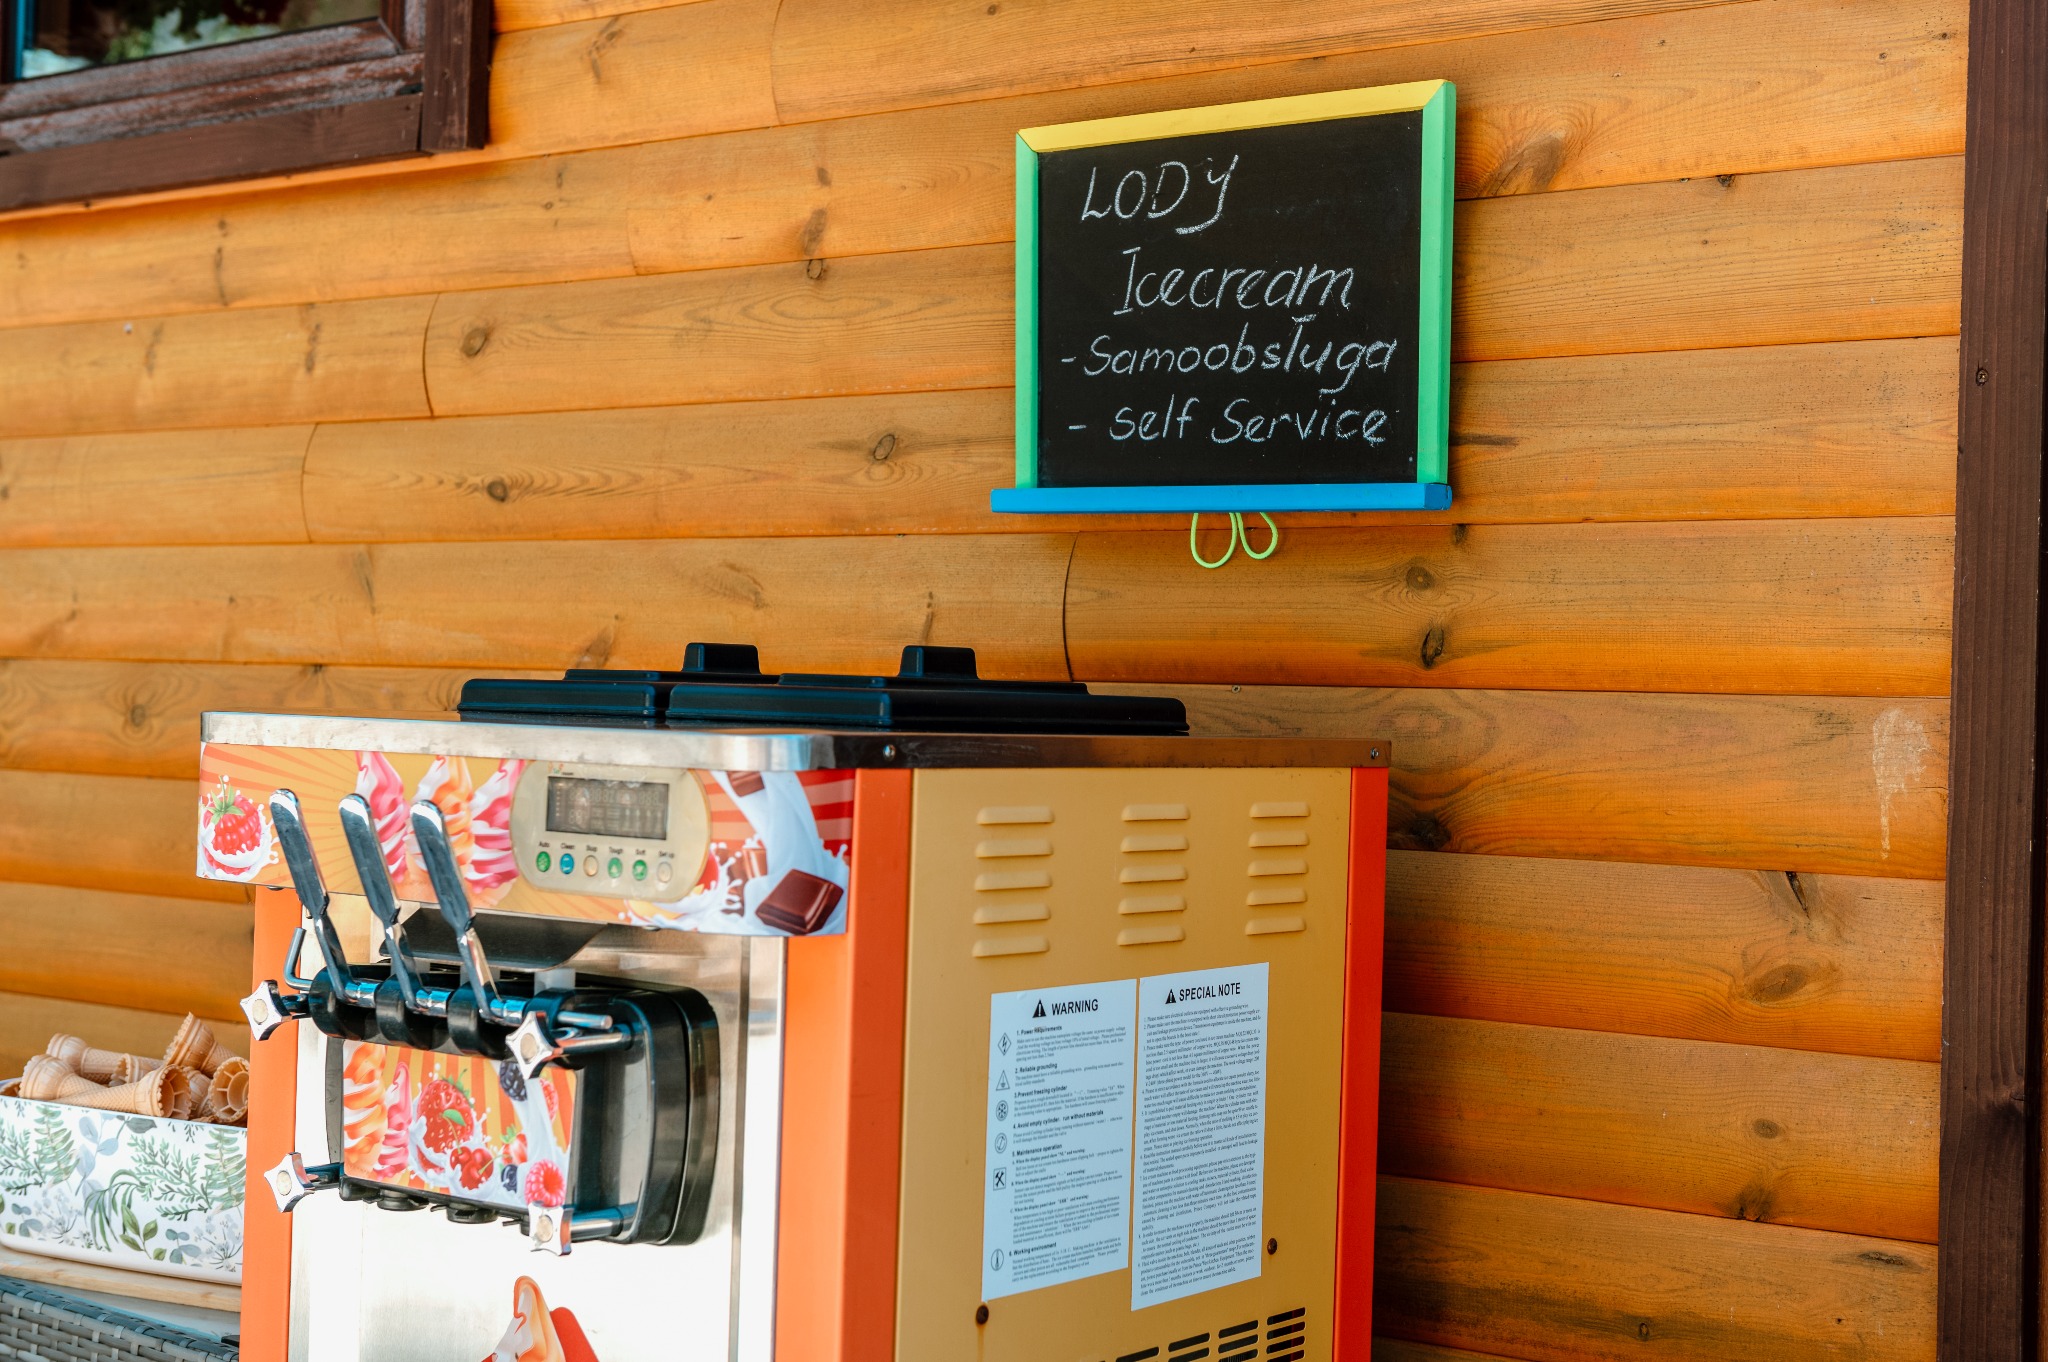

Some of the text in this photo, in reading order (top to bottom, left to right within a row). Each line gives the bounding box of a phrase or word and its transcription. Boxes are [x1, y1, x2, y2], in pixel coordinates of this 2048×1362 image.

[1081, 154, 1239, 235] LODY
[1113, 246, 1354, 315] Icecream
[1211, 397, 1389, 448] Service
[1179, 982, 1240, 1002] SPECIAL NOTE
[1052, 998, 1098, 1016] WARNING
[1037, 1063, 1058, 1072] grounding
[1034, 1087, 1050, 1096] freezing
[1030, 1120, 1042, 1128] empty
[1016, 1148, 1042, 1156] Maintenance
[1043, 1144, 1062, 1152] operation
[1013, 1247, 1030, 1256] Working
[1031, 1242, 1056, 1252] environment
